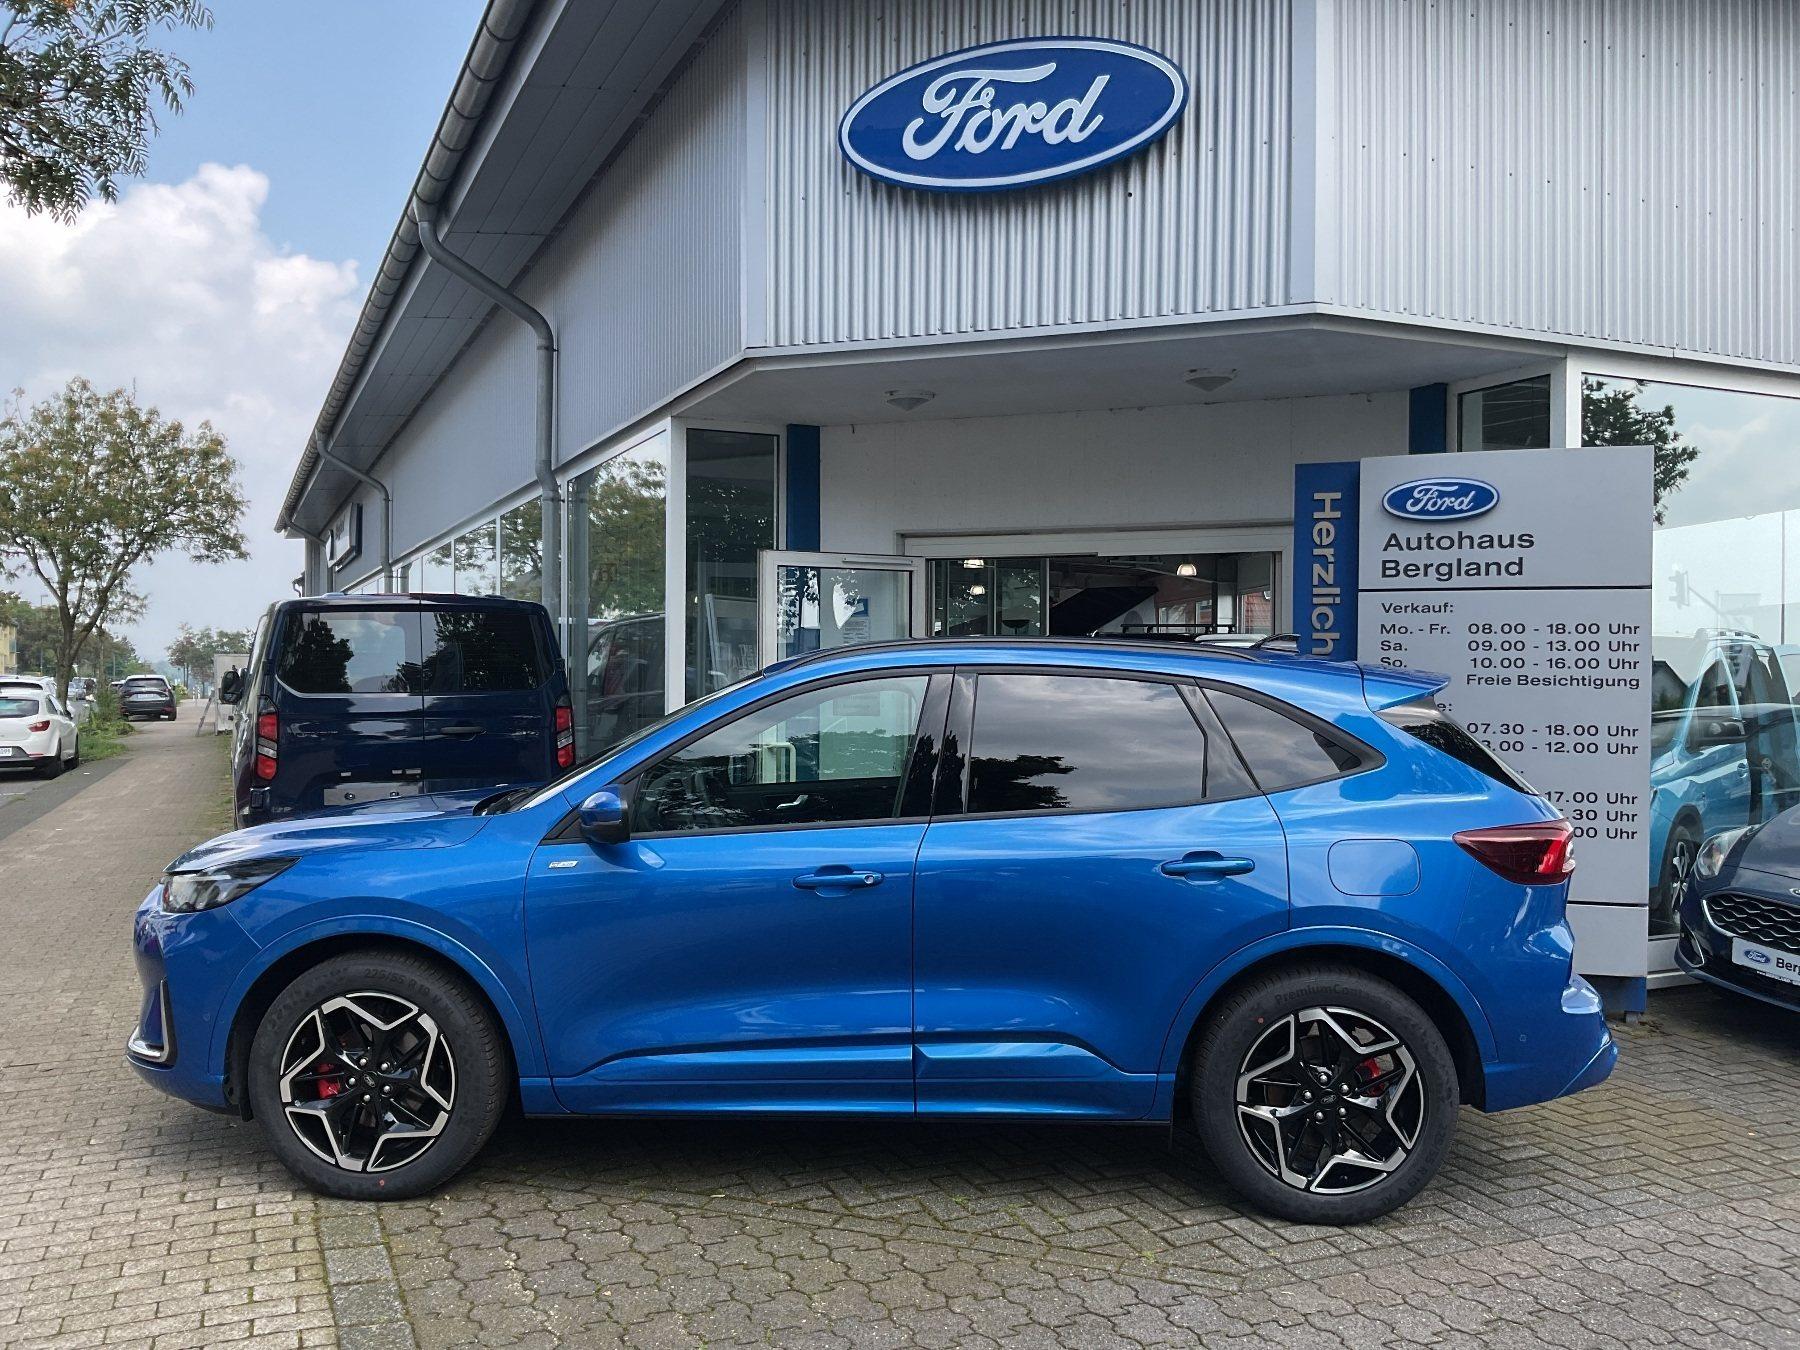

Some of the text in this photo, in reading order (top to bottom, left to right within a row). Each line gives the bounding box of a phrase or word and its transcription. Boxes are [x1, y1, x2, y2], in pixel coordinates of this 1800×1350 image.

[902, 62, 1112, 161] Ford
[1405, 483, 1476, 512] Ford
[1383, 531, 1535, 552] Autohaus
[1311, 492, 1342, 655] Herzlich
[1381, 557, 1524, 582] Bergland
[1381, 602, 1454, 614] Verkauf:
[1380, 623, 1413, 635] Mo.
[1430, 623, 1451, 635] Fr.
[1468, 622, 1526, 635] 08.00
[1545, 622, 1601, 635] 18.00
[1608, 622, 1641, 635] Uhr
[1381, 640, 1408, 652] Sa.
[1467, 639, 1526, 652] 09.00
[1545, 639, 1601, 653] 13.00
[1608, 640, 1640, 653] Uhr
[1380, 656, 1408, 669] So.
[1470, 657, 1526, 669] 10.00
[1545, 657, 1600, 670] 16.00
[1608, 657, 1640, 670] Uhr
[1466, 674, 1640, 690] Freie Besichtigung
[1466, 722, 1525, 735] 07.30
[1544, 724, 1599, 737] 18.00
[1607, 725, 1639, 738] Uhr
[1544, 741, 1599, 754] 12.00
[1606, 742, 1639, 755] Uhr
[1606, 792, 1638, 804] Uhr
[1606, 810, 1638, 822] Uhr
[1606, 827, 1638, 840] Uhr
